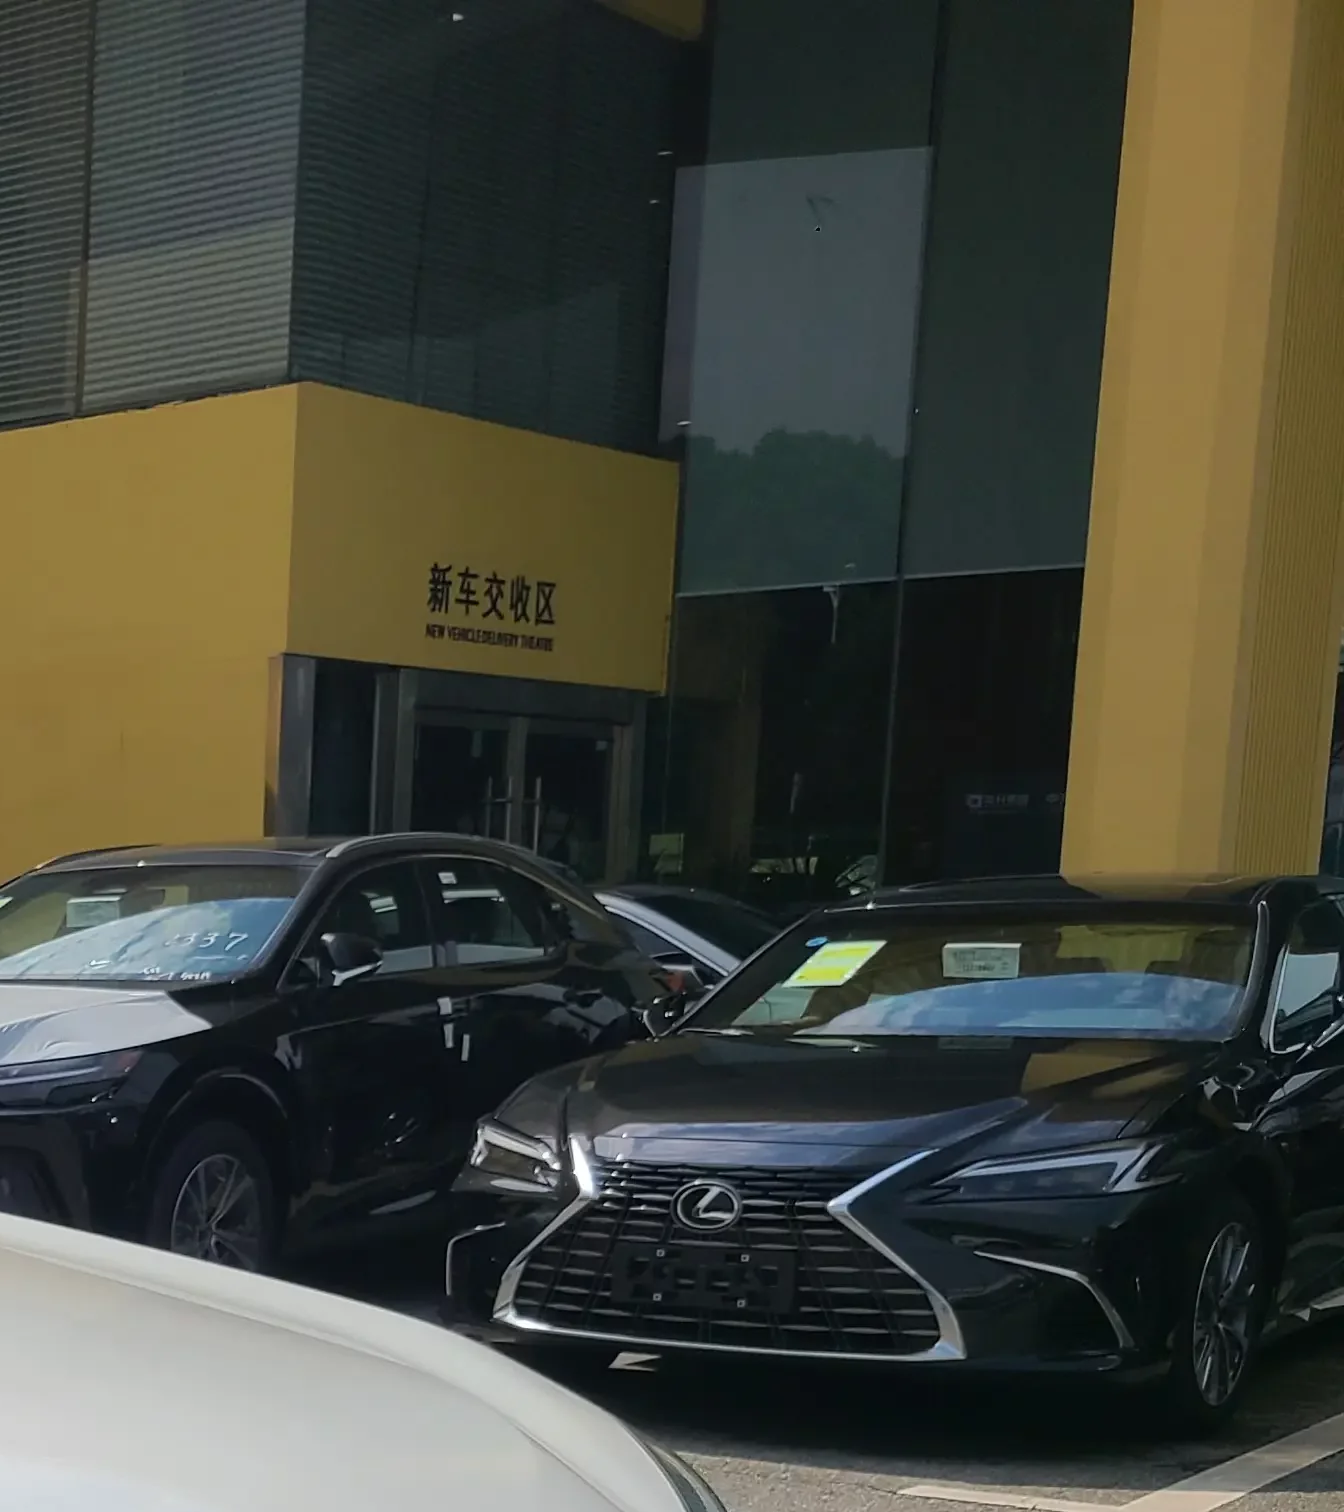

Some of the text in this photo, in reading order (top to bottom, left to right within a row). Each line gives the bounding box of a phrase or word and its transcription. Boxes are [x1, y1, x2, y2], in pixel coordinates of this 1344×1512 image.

[427, 562, 556, 626] 新车交收区
